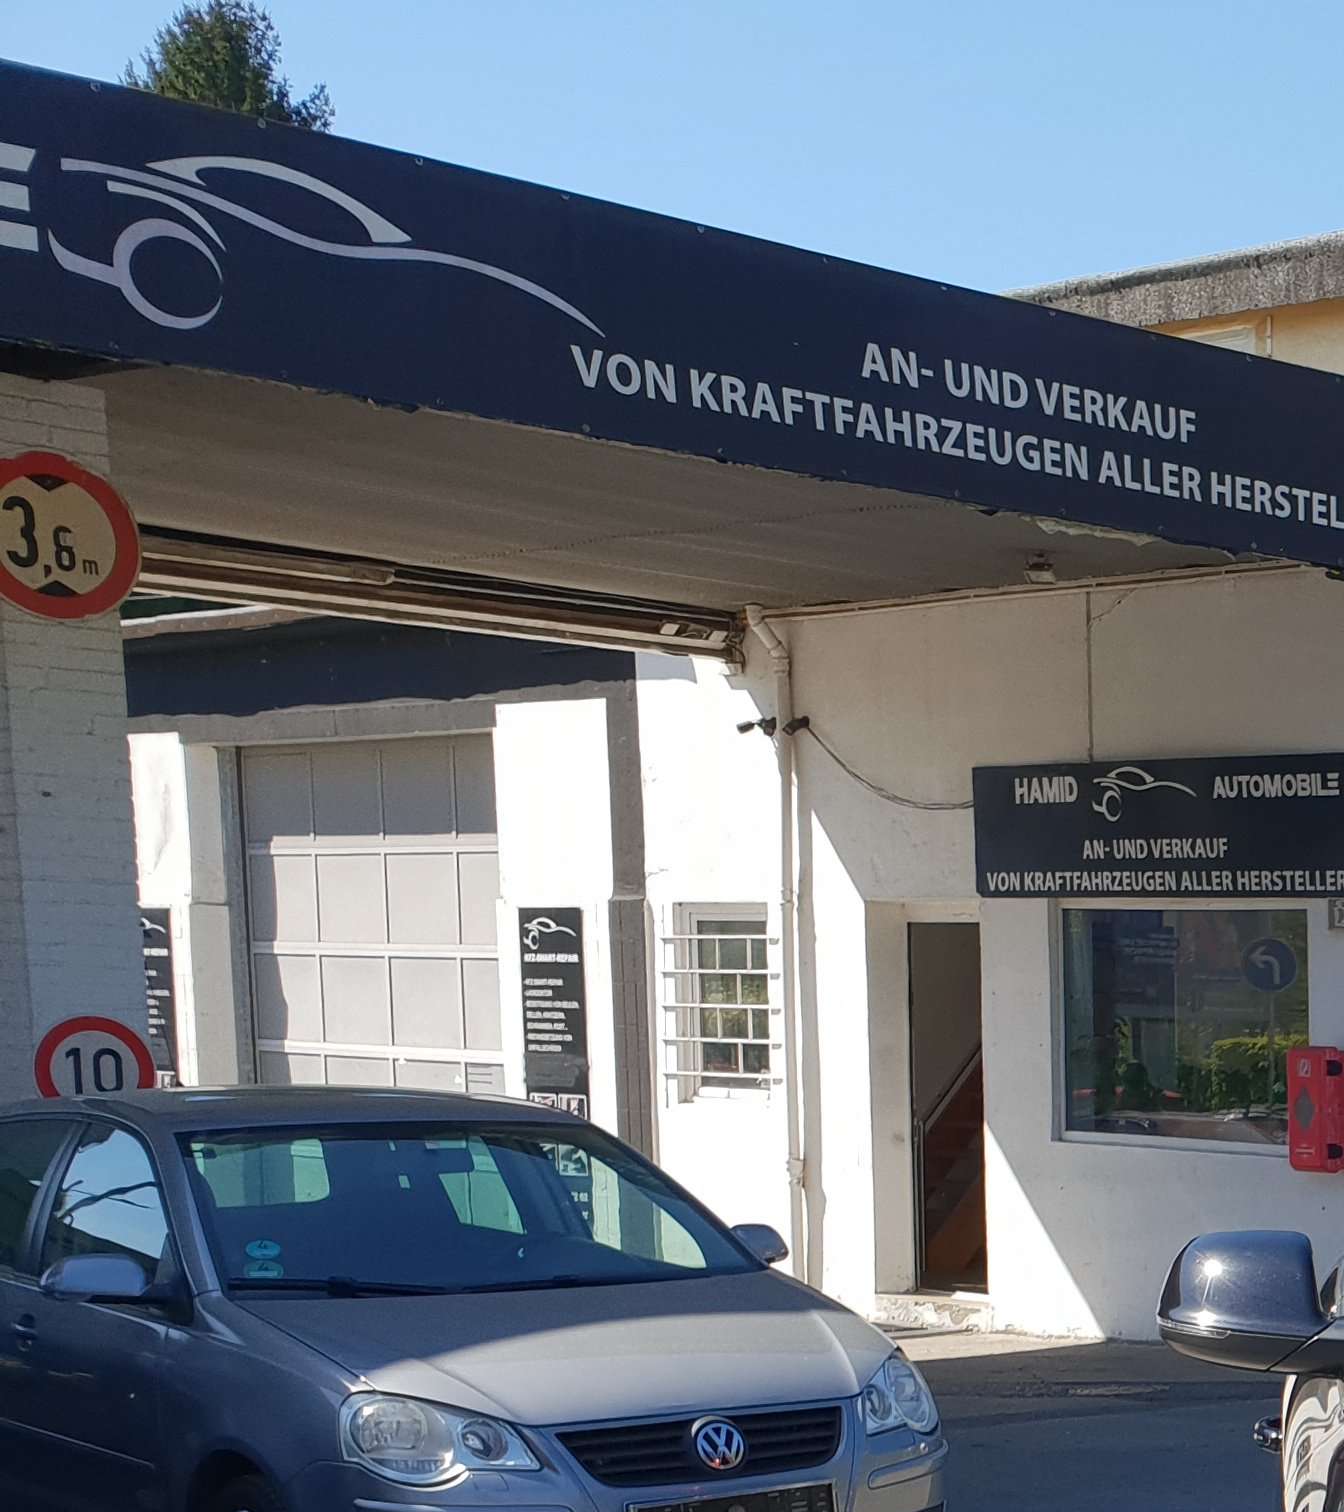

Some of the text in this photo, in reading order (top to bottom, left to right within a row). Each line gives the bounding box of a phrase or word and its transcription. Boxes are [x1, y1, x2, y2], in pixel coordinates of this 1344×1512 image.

[861, 342, 1197, 445] AN- UND VERKAUF
[570, 344, 677, 404] VON
[690, 368, 1090, 483] KRAFTFAHRZEUGEN
[1098, 450, 1202, 504] ALLER
[1014, 772, 1340, 804] HAMID AUTOMOBILE
[1083, 837, 1228, 860] AN- UND VERKAUF
[987, 872, 1020, 892] VON
[1024, 871, 1177, 892] KRAFTFAHRZEUGEN
[1180, 870, 1233, 892] ALLER
[65, 1048, 123, 1095] 10
